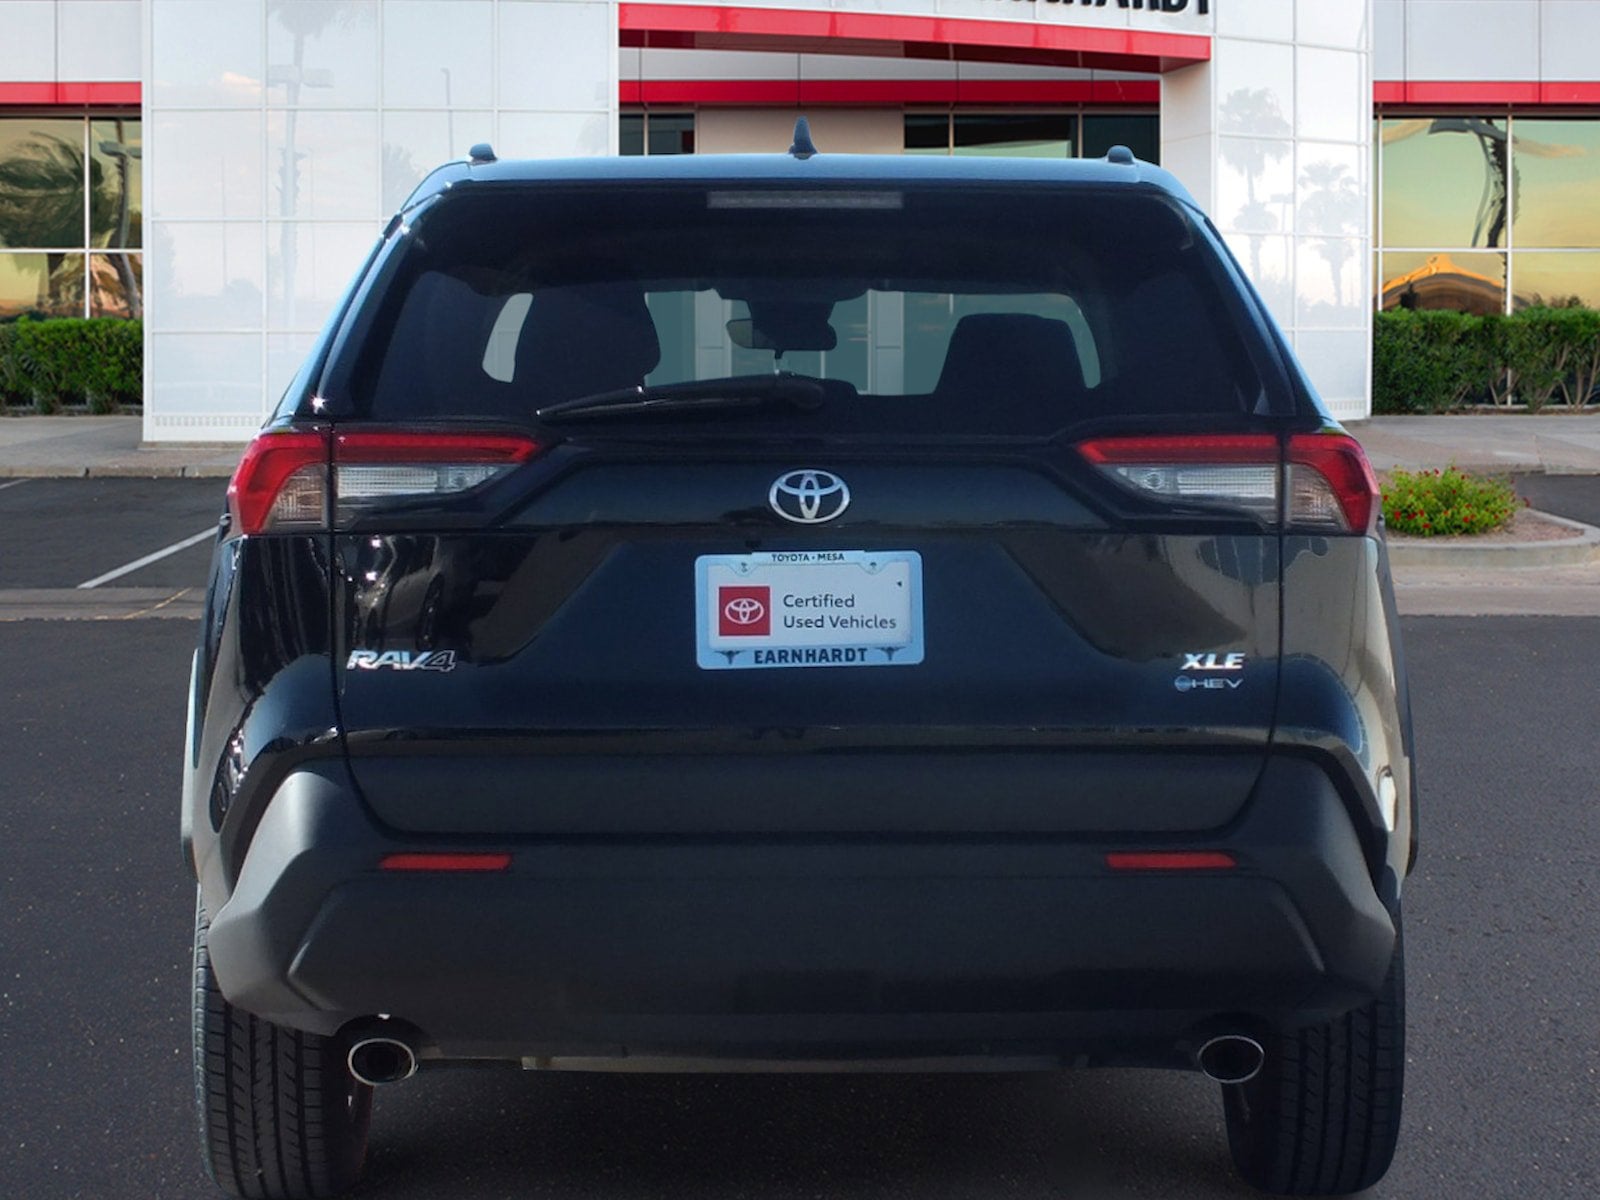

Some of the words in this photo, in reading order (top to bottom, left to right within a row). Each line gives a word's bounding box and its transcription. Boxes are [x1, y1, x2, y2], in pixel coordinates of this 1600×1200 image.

[771, 553, 810, 562] TOYOTA
[817, 553, 845, 561] MESA
[783, 594, 855, 608] Certified
[783, 616, 824, 629] Used
[829, 615, 897, 629] Vehicles
[346, 649, 456, 672] RAV4
[754, 648, 868, 665] EARNHARDT
[1180, 653, 1246, 670] XLE
[1191, 679, 1243, 689] HEV
